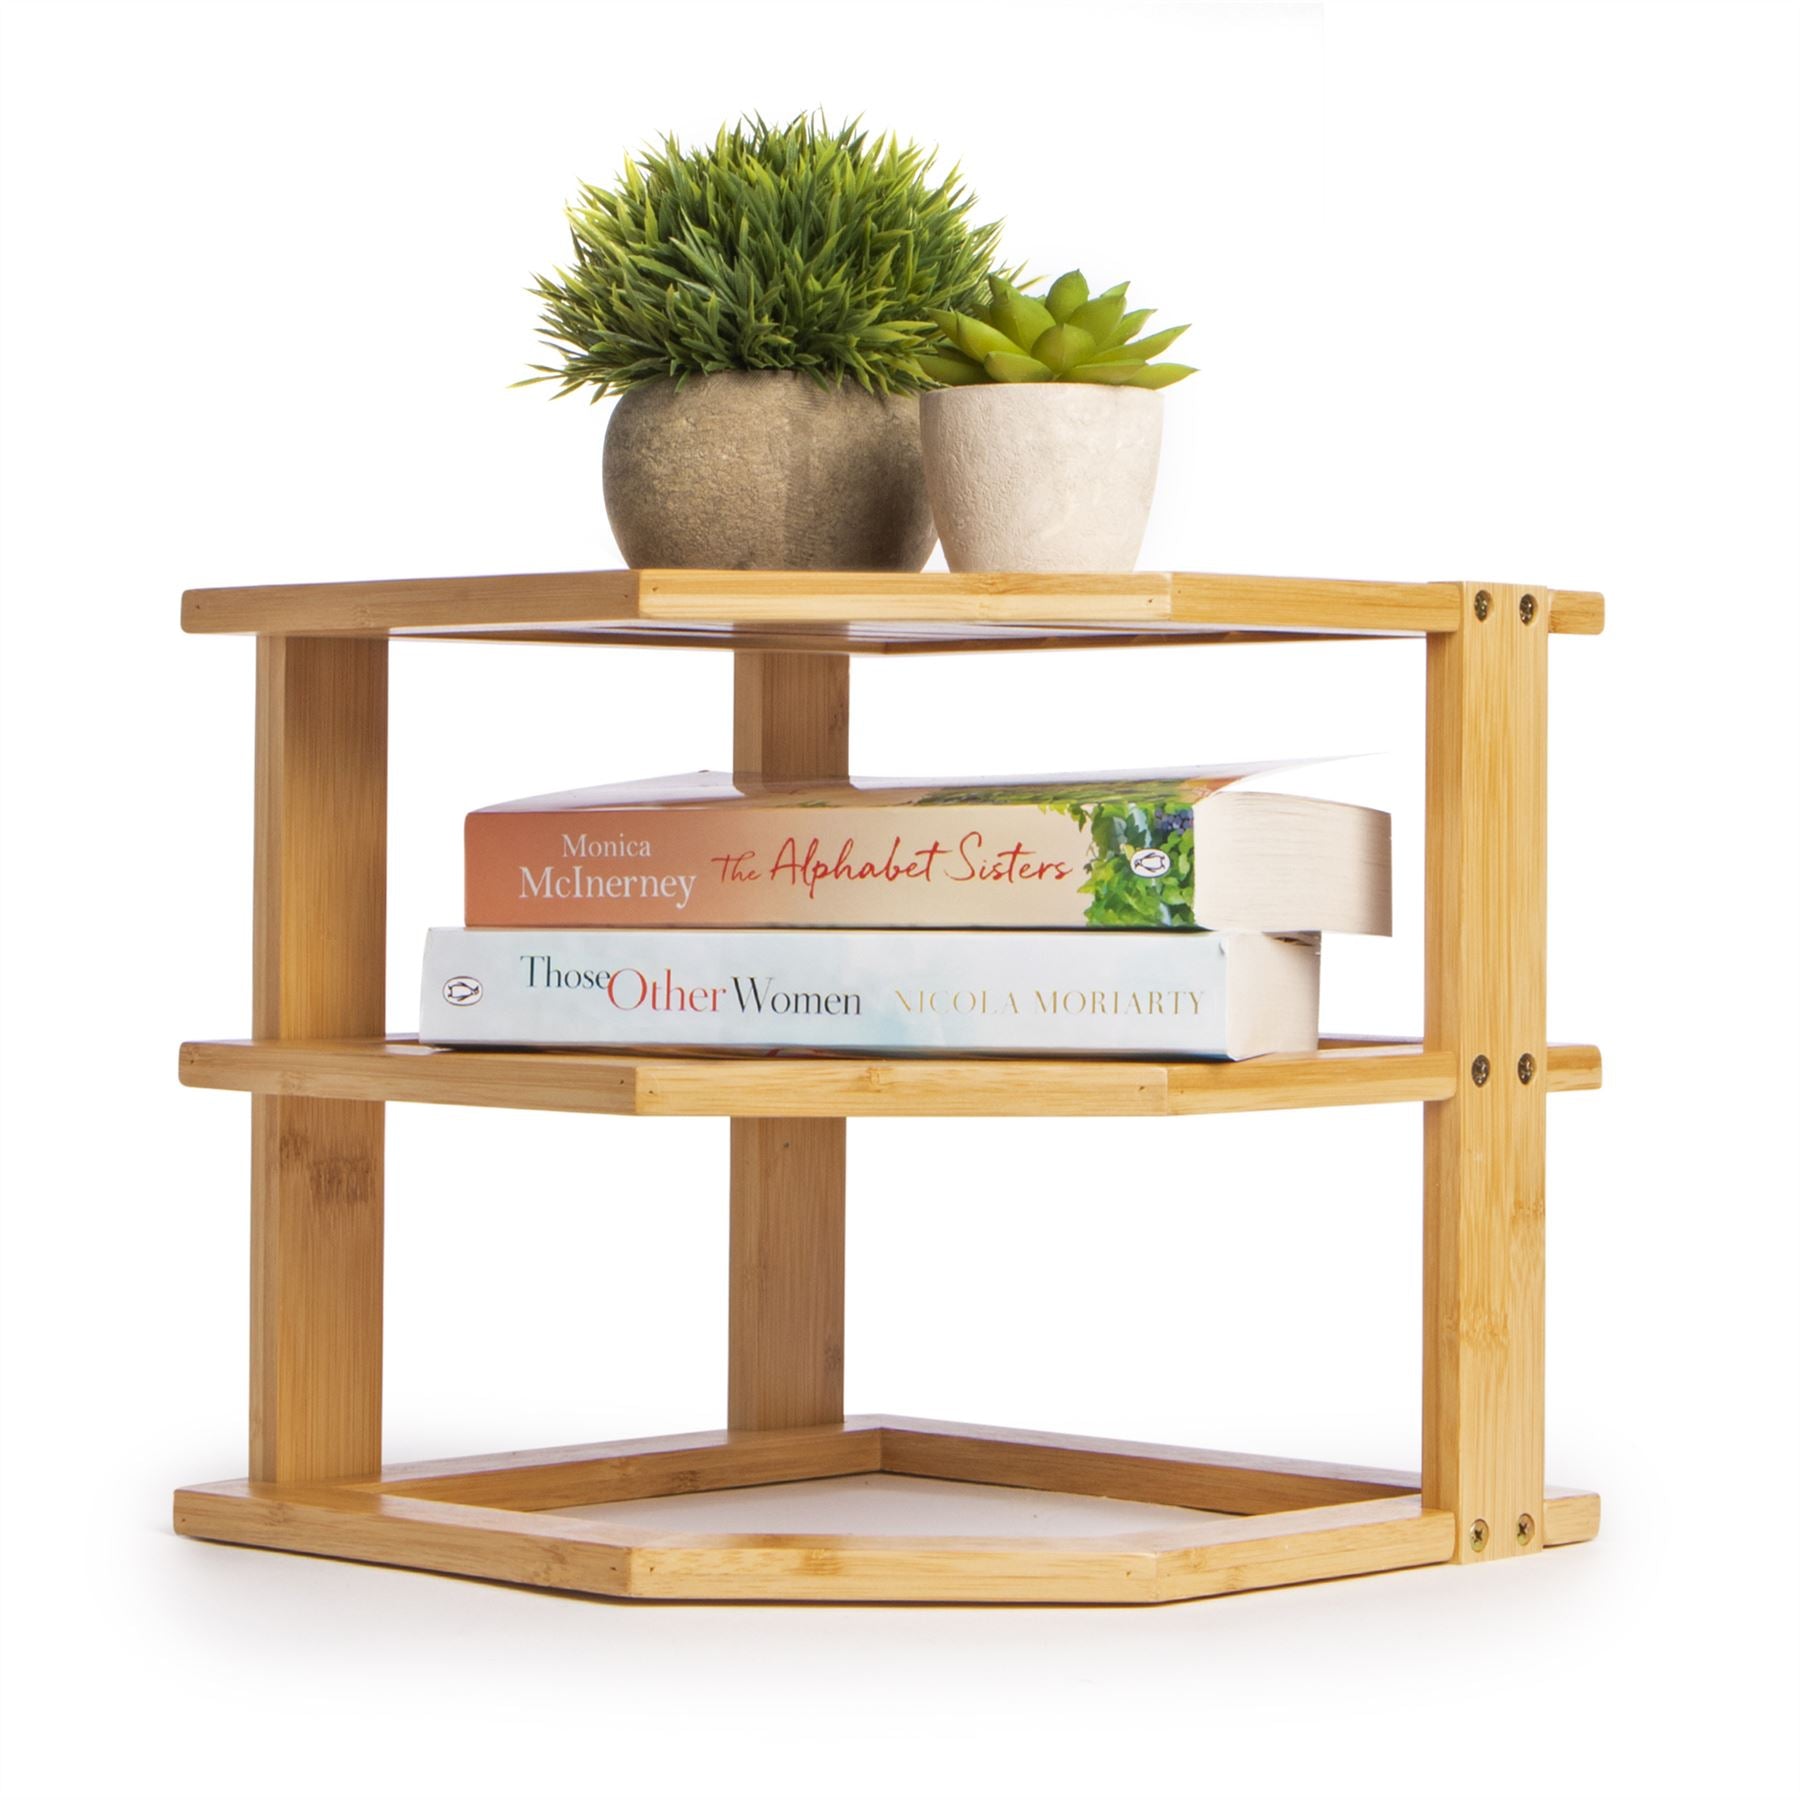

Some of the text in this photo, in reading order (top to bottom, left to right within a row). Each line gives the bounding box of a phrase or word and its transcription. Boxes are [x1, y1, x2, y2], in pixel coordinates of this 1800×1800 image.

[561, 833, 651, 858] Monica
[711, 831, 1073, 899] The Alphabet Sisters
[519, 866, 697, 909] McInerney
[520, 955, 861, 1015] Those Other Women
[894, 989, 1206, 1017] NICOLA MORIARTY
